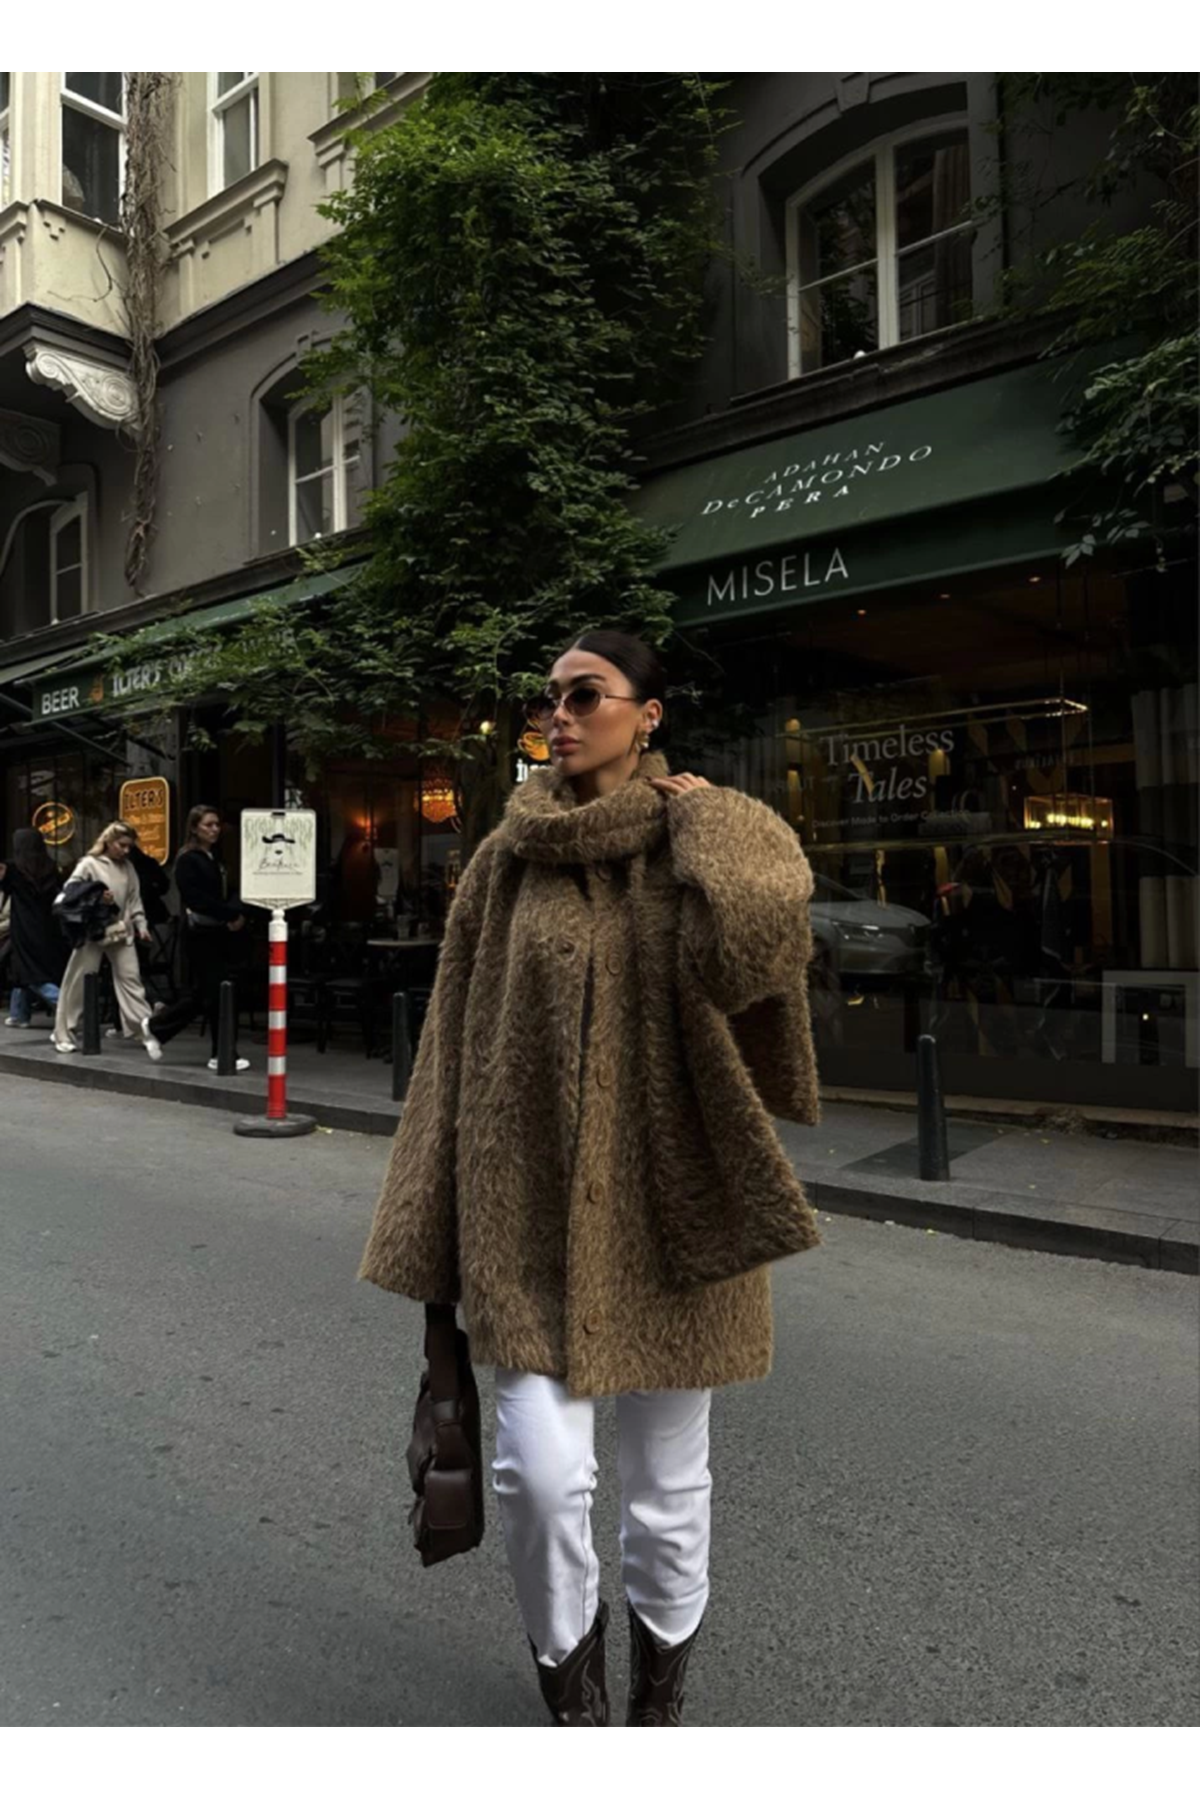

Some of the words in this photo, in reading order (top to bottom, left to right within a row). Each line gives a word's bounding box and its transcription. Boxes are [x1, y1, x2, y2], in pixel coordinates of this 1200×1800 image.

[764, 442, 885, 484] ADAHAN
[749, 485, 850, 519] PERA
[706, 547, 849, 606] MISELA
[41, 686, 80, 715] BEER
[819, 723, 956, 767] Timeless
[847, 765, 928, 804] Tales
[811, 818, 849, 829] Discover
[851, 815, 877, 827] Made
[878, 815, 889, 824] to
[890, 812, 919, 823] Order
